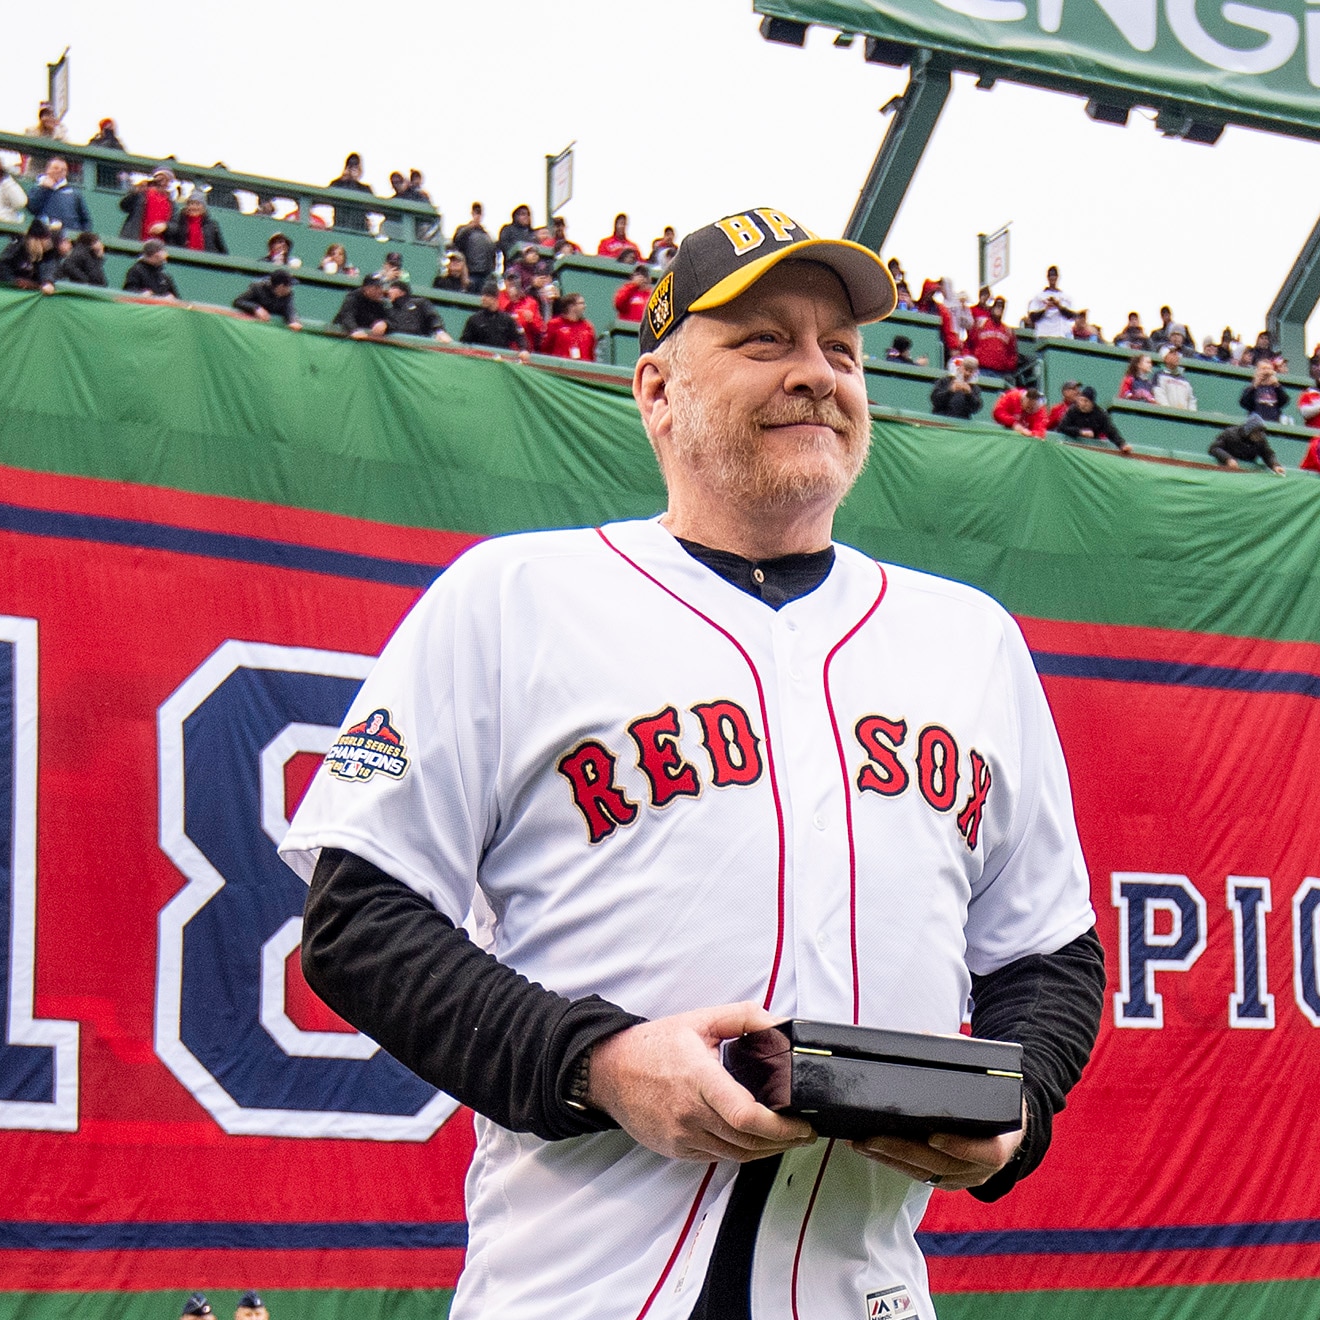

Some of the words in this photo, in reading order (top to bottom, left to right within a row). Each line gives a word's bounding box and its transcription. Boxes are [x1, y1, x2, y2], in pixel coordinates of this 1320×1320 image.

[714, 207, 820, 257] BP
[327, 745, 404, 774] CHAMPIONS
[365, 740, 401, 757] SERIES
[557, 698, 765, 846] RED
[854, 715, 993, 853] SOX
